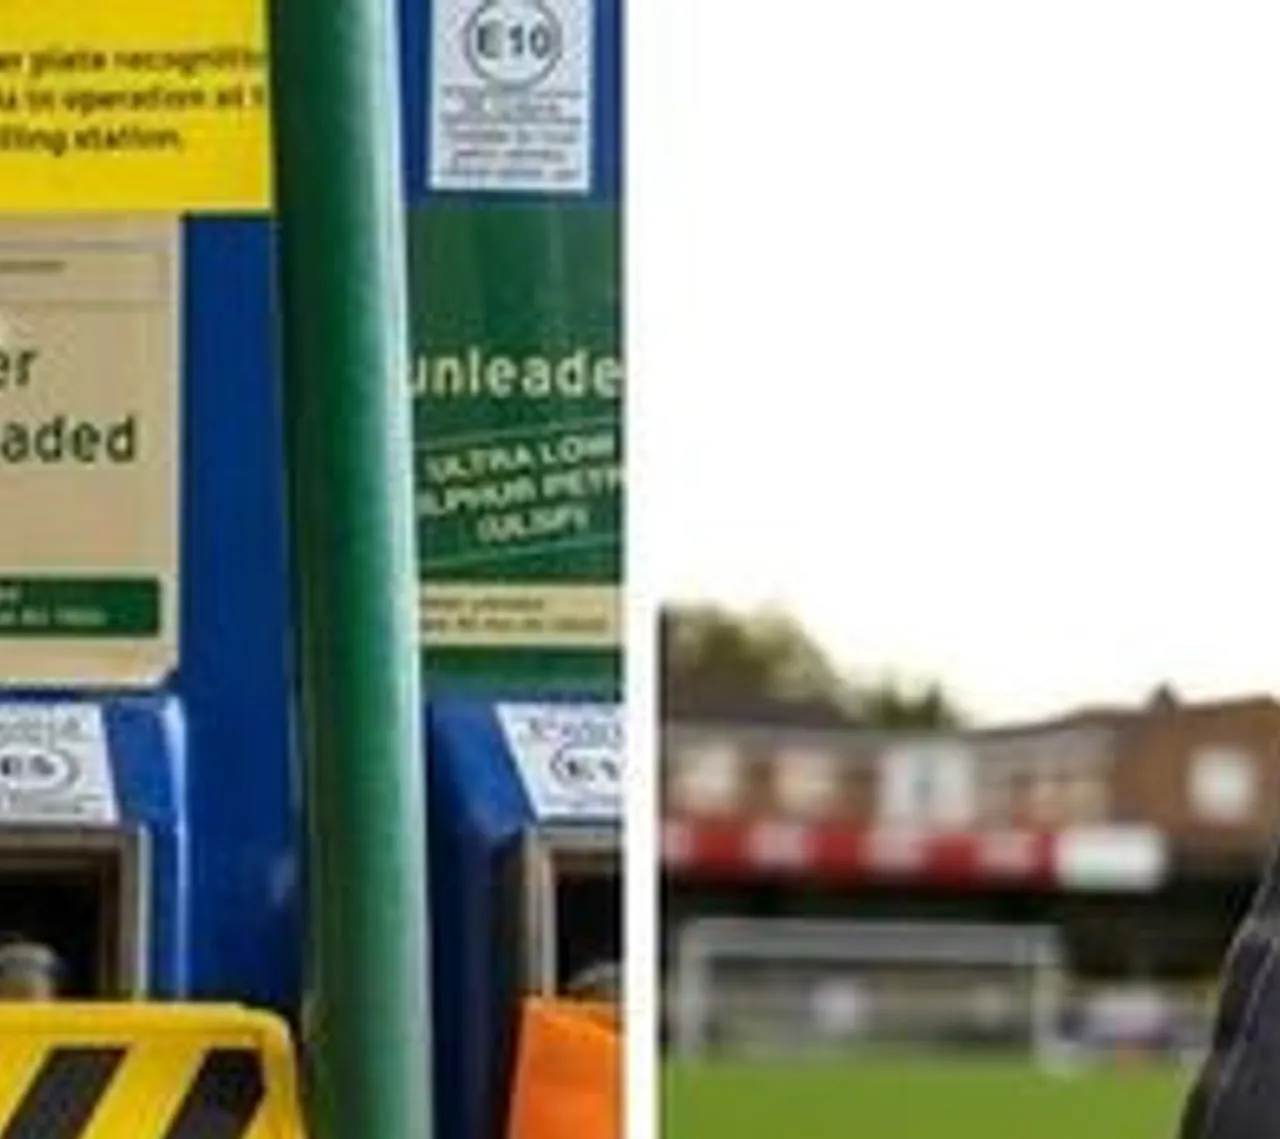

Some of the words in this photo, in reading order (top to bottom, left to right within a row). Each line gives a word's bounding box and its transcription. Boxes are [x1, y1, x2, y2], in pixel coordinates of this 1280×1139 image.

[476, 21, 552, 60] E10
[30, 46, 107, 78] plate
[63, 85, 205, 116] operation
[425, 443, 535, 483] ULTRA
[0, 753, 57, 779] E5
